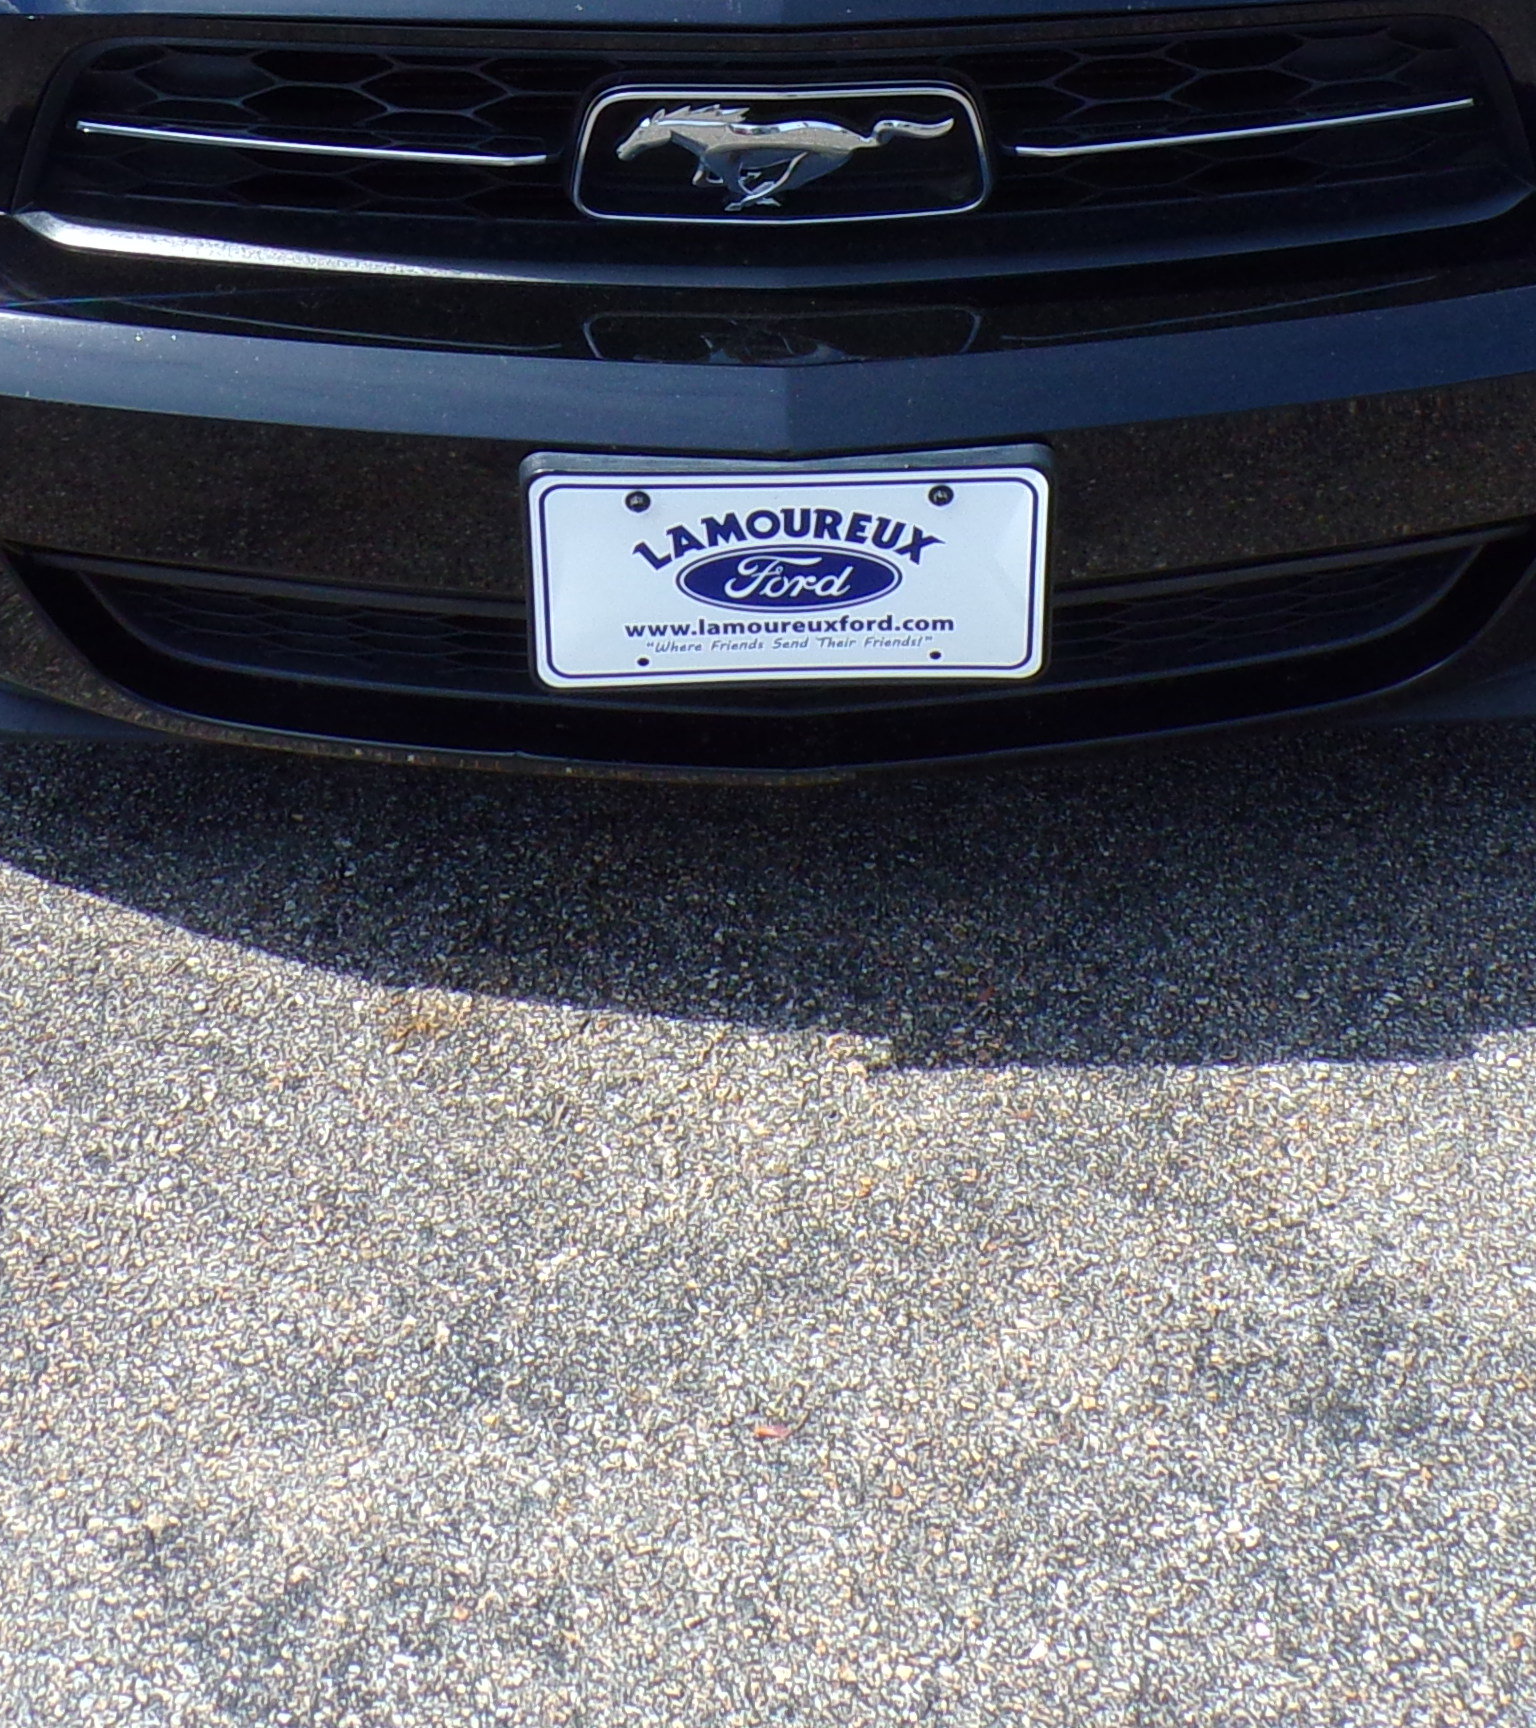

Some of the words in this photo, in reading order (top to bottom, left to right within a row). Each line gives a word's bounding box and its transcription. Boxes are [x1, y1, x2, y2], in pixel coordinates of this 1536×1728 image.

[632, 508, 946, 570] LAMOUREUX
[724, 555, 854, 599] Ford
[624, 614, 955, 637] www.lamoureuxford.com
[711, 638, 764, 651] Friends
[772, 637, 810, 650] Send
[816, 636, 857, 649] Their
